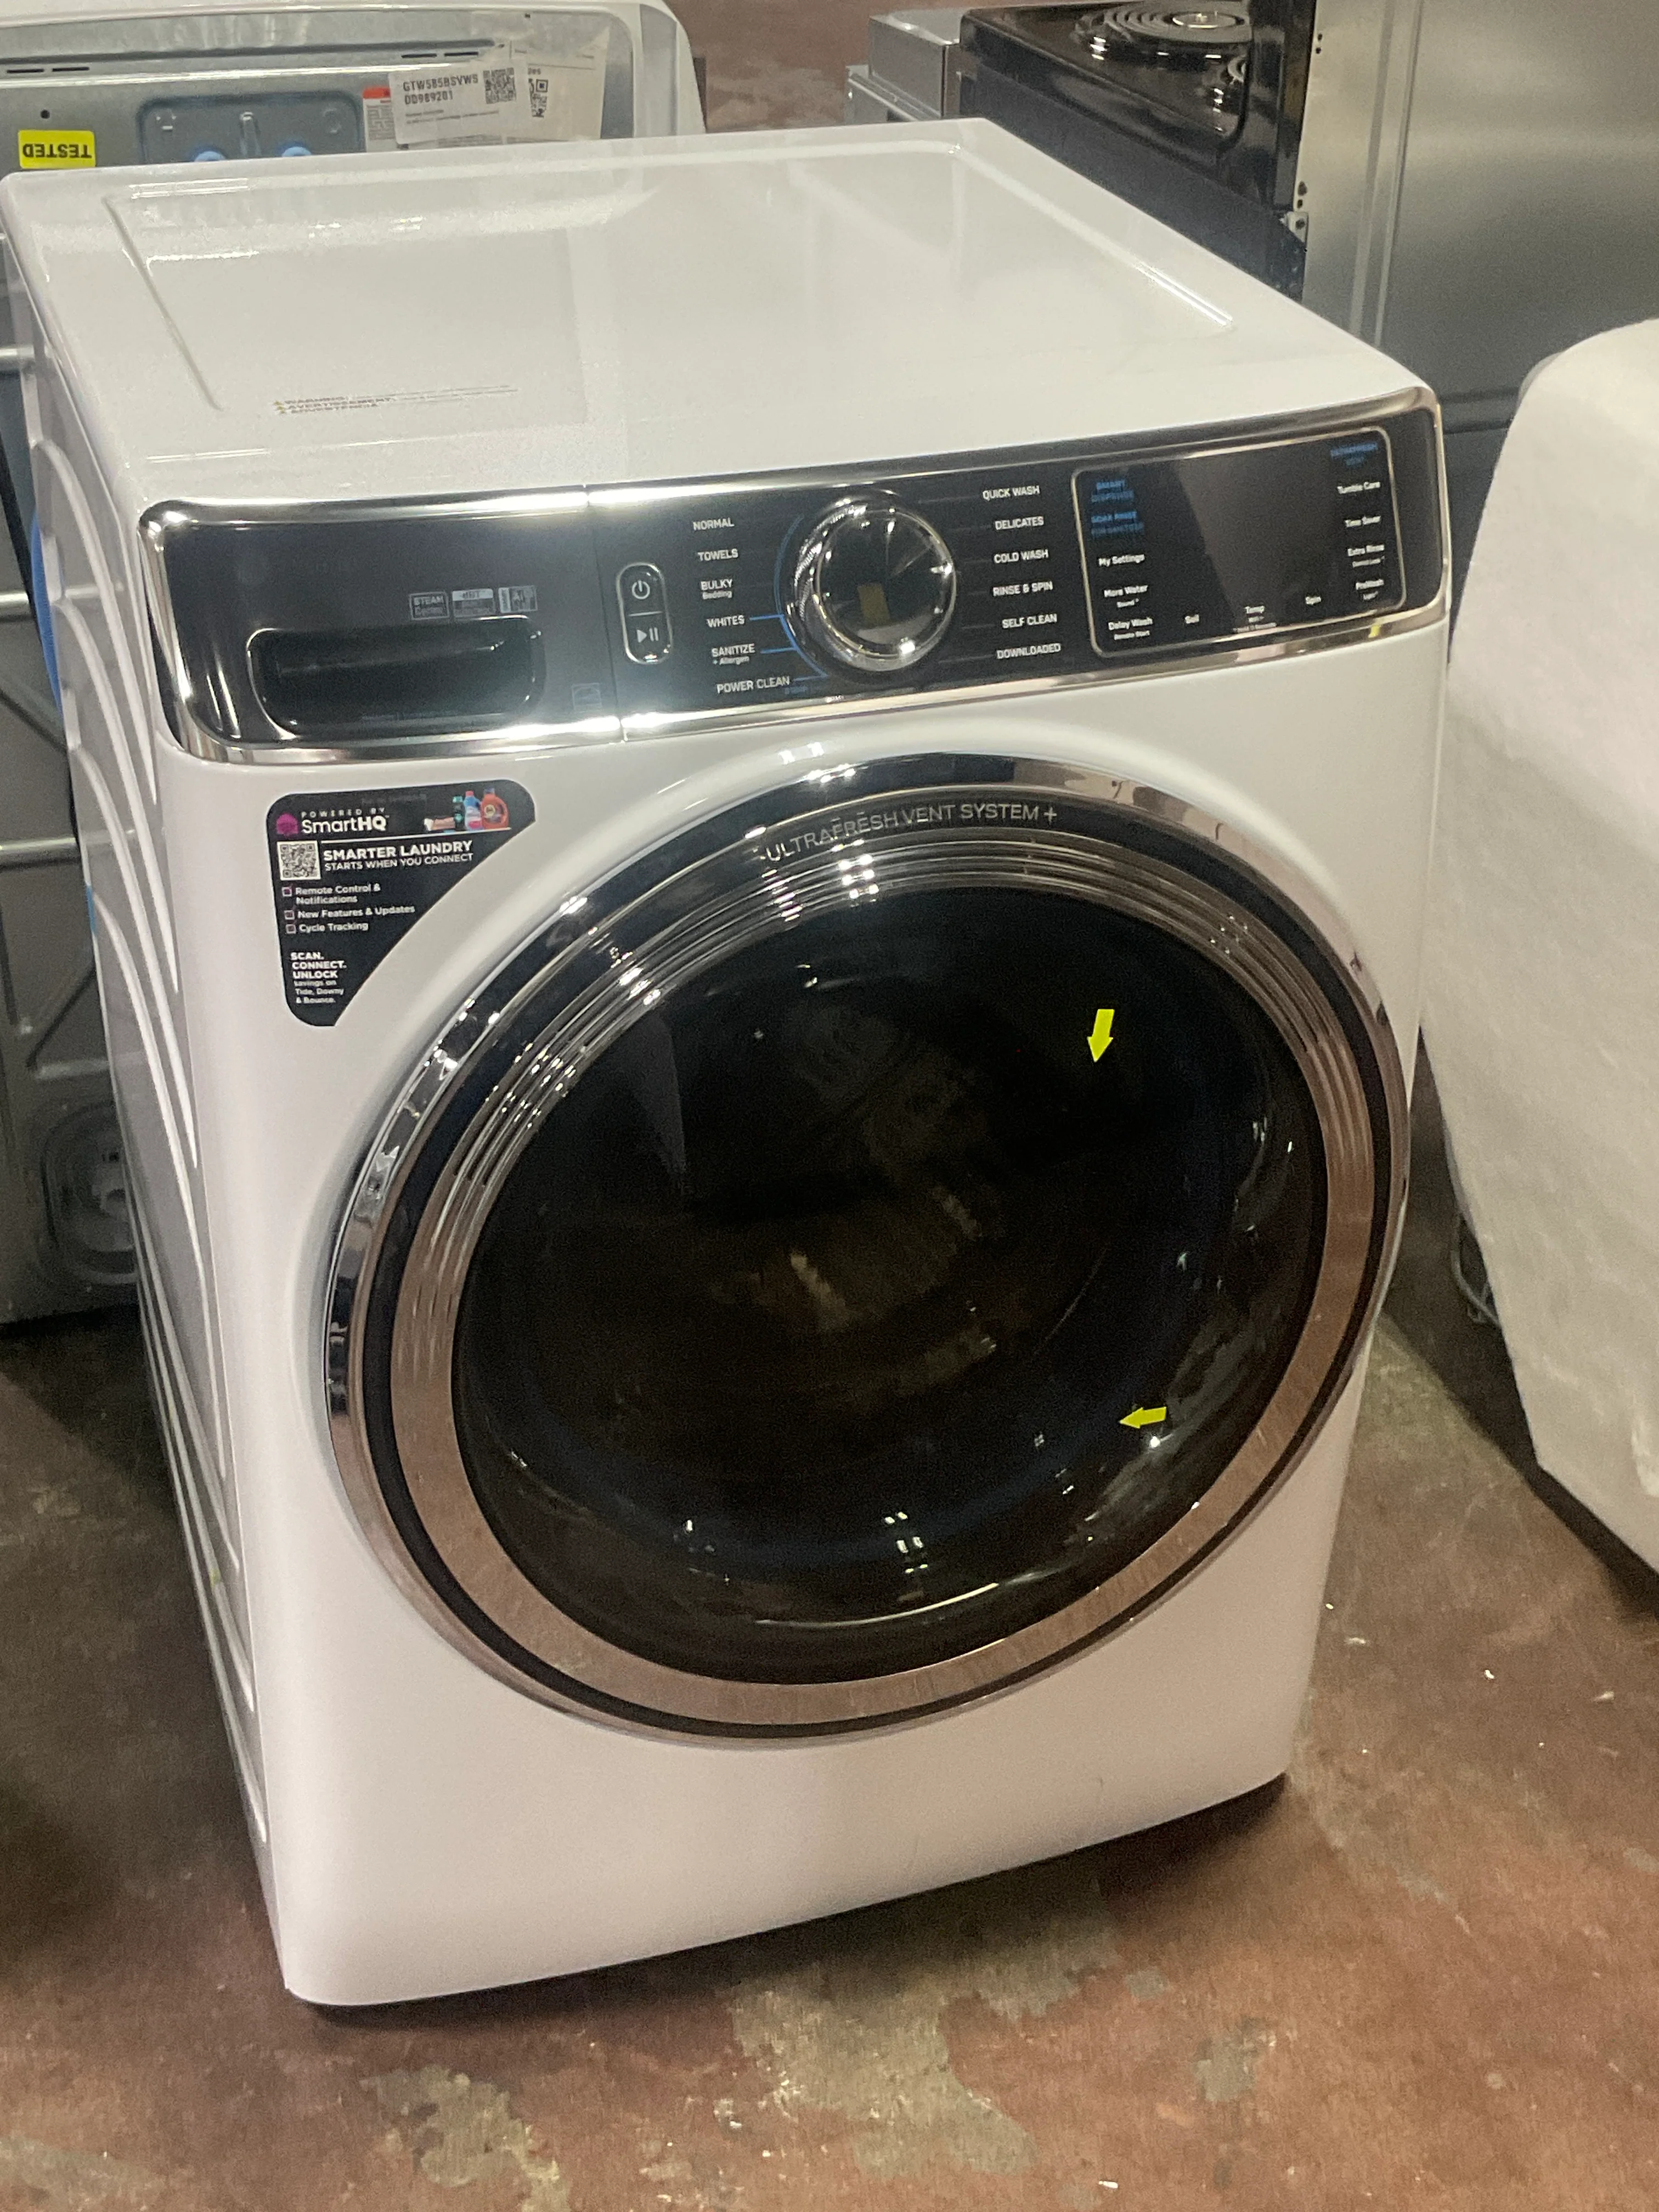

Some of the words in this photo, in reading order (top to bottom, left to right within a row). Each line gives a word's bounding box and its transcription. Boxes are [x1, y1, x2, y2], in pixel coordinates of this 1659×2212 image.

[22, 144, 92, 159] TESTED
[982, 488, 1011, 501] QUICK
[1013, 485, 1040, 496] WASH
[693, 517, 735, 531] NORMAL
[995, 516, 1044, 531] DELICATES
[697, 549, 738, 562] TOWELS
[994, 552, 1019, 563] COLD
[1021, 549, 1049, 561] WASH
[701, 579, 732, 591] BULKY
[992, 584, 1020, 596] RINSE
[1023, 584, 1029, 593] &
[1031, 581, 1053, 592] SPIN
[707, 615, 744, 628] WHITES
[1002, 618, 1025, 629] SELF
[1027, 613, 1057, 625] CLEAN
[712, 643, 755, 657] SANITIZE
[996, 642, 1062, 659] DOWNLOADED
[716, 680, 754, 694] POWER
[757, 676, 790, 689] CLEAN
[300, 808, 362, 818] POWERED
[302, 815, 387, 834] SmartHQ
[766, 811, 899, 861] ULTRAFRESH
[902, 804, 956, 824] VENT
[960, 803, 1039, 820] SYSTEM
[323, 846, 397, 861] SMARTER
[400, 840, 473, 856] LAUNDRY
[325, 860, 363, 872] STARTS
[365, 859, 398, 868] WHEN
[400, 857, 422, 866] YOU
[424, 853, 473, 865] CONNECT
[335, 884, 371, 894] Control
[374, 883, 381, 892] &
[296, 896, 358, 905] Notifications
[298, 910, 319, 918] New
[321, 909, 363, 918] Features
[365, 907, 373, 916] &
[375, 906, 415, 916] Updates
[299, 924, 325, 933] Cycle
[328, 922, 369, 932] Tracking
[290, 952, 324, 960] SCAN.
[292, 960, 347, 970] CONNECT.
[293, 970, 338, 979] UNLOCK
